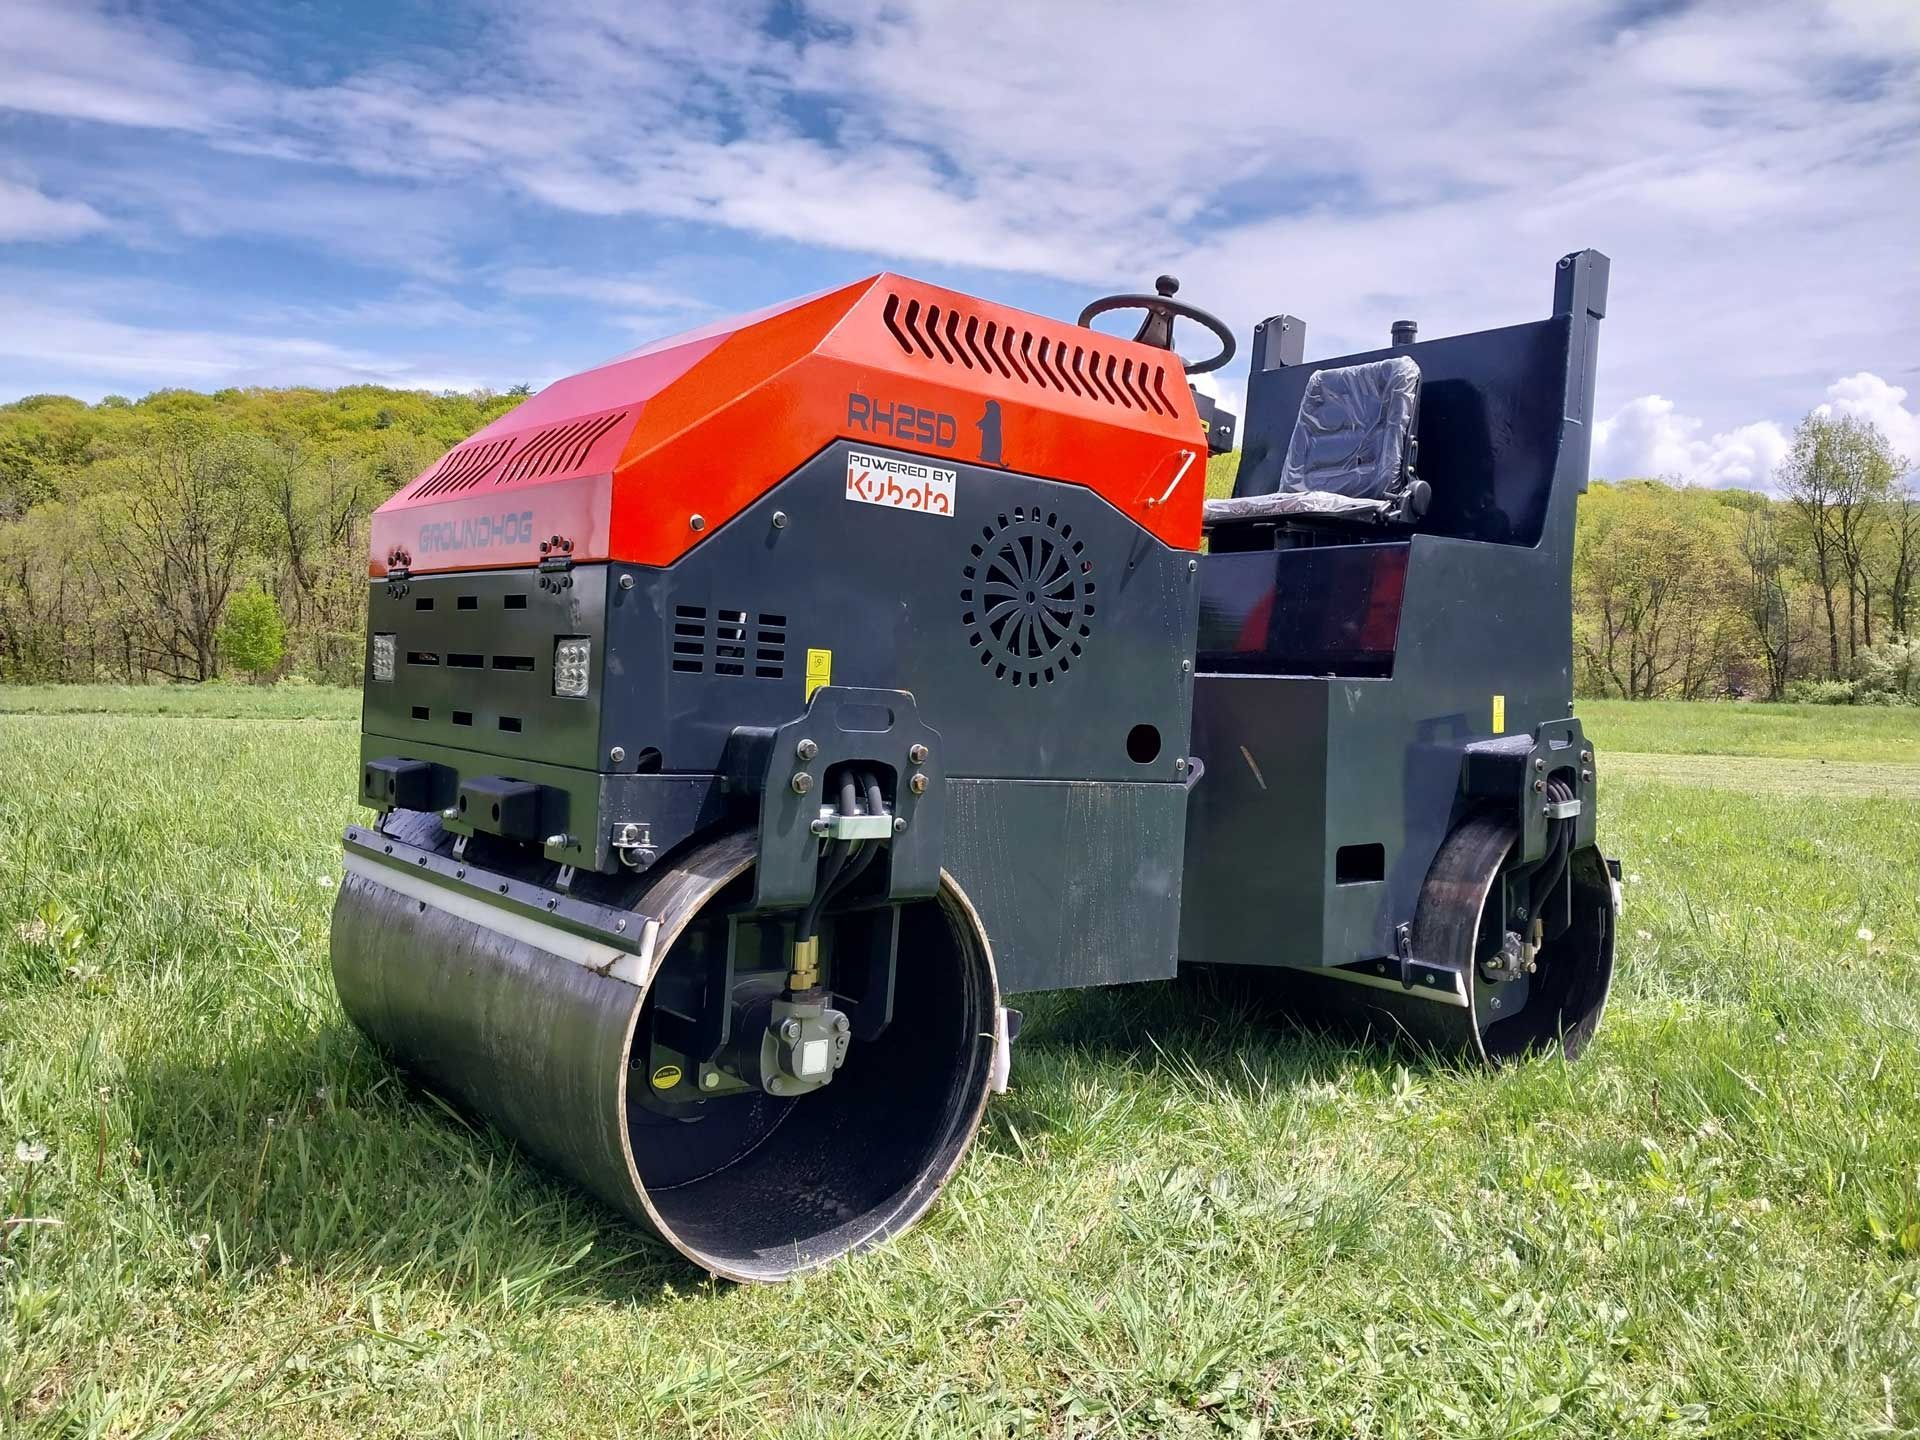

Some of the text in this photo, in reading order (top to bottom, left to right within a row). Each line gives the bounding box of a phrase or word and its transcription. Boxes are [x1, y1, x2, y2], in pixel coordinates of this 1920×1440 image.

[849, 454, 955, 483] POWERED BY
[848, 468, 949, 514] Kubota
[419, 511, 533, 553] GROUNDHOG
